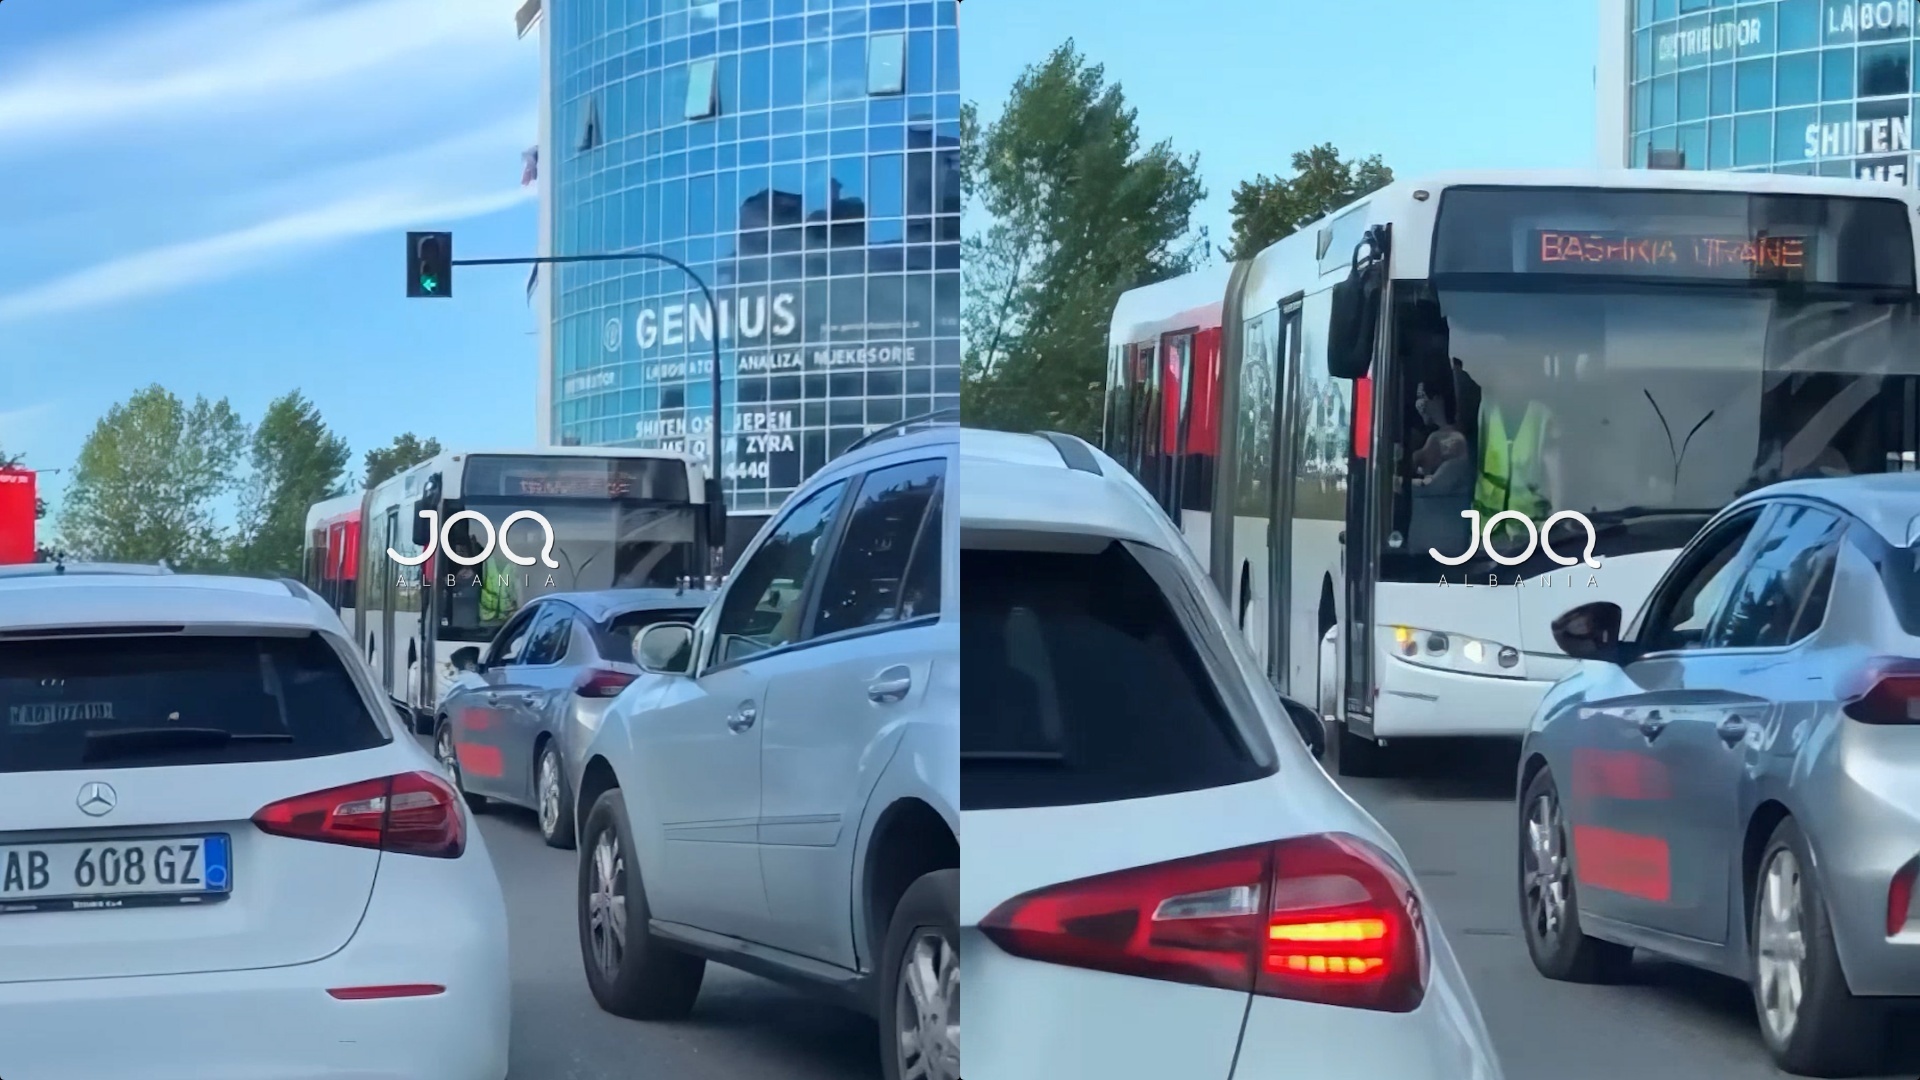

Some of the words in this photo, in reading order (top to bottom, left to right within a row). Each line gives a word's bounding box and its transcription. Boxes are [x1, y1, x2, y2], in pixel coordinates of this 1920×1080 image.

[1828, 0, 1920, 32] LABOR
[1804, 116, 1910, 158] SHITEN
[636, 293, 796, 349] GENIUS
[739, 353, 801, 371] ANALIZA
[746, 435, 795, 454] ZYRA
[4, 851, 50, 892] AB
[75, 847, 146, 887] 608
[154, 845, 200, 884] GZ
